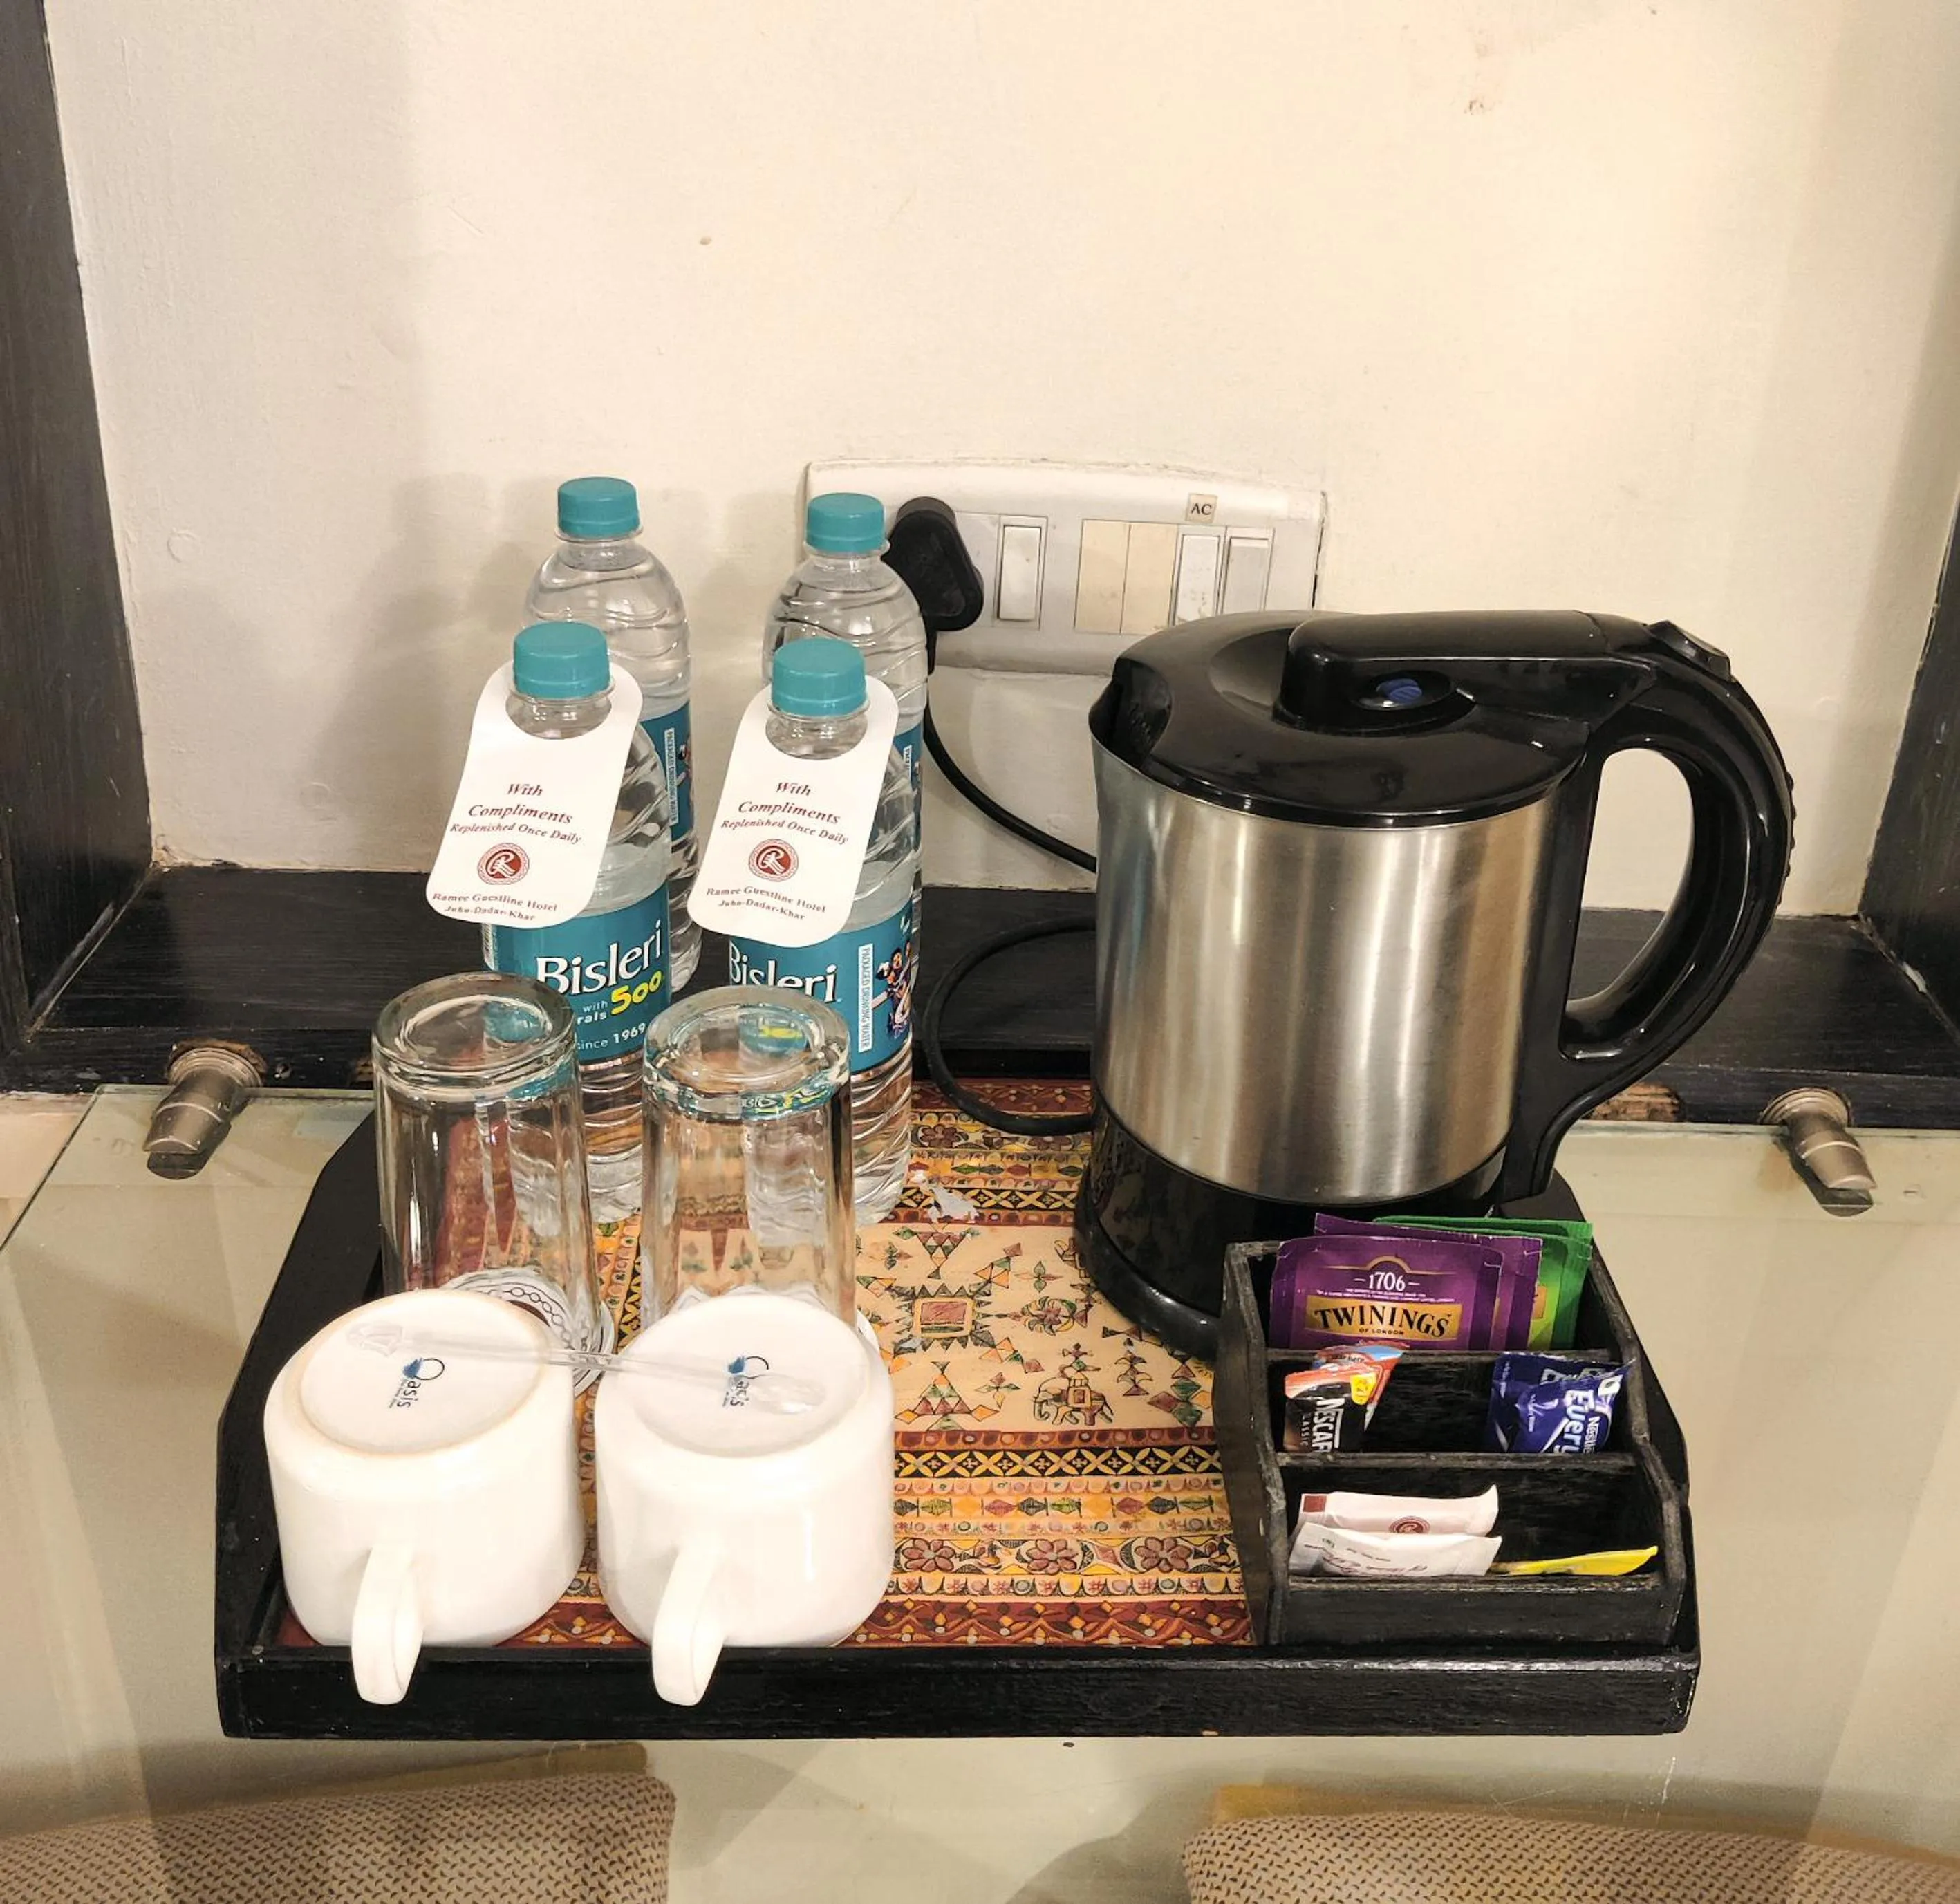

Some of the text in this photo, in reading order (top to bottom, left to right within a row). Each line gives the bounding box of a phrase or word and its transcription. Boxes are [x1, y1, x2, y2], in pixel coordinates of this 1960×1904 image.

[1191, 503, 1212, 515] AC
[507, 783, 543, 796] With
[775, 782, 812, 796] With
[468, 804, 573, 825] Compliments
[738, 801, 841, 825] Compliments
[449, 823, 582, 845] Replenished Once Daily
[720, 819, 849, 845] Replenished Once Daily
[743, 885, 794, 904] Guestline
[796, 899, 827, 913] Hotel
[536, 919, 662, 995] Bisleri
[729, 939, 837, 1002] Bisleri
[611, 971, 663, 1015] 500
[582, 1001, 608, 1013] with
[613, 1023, 646, 1044] 1969
[1369, 1272, 1406, 1291] 1706
[1314, 1305, 1450, 1338] TWININGS
[1312, 1398, 1345, 1453] NESCAF
